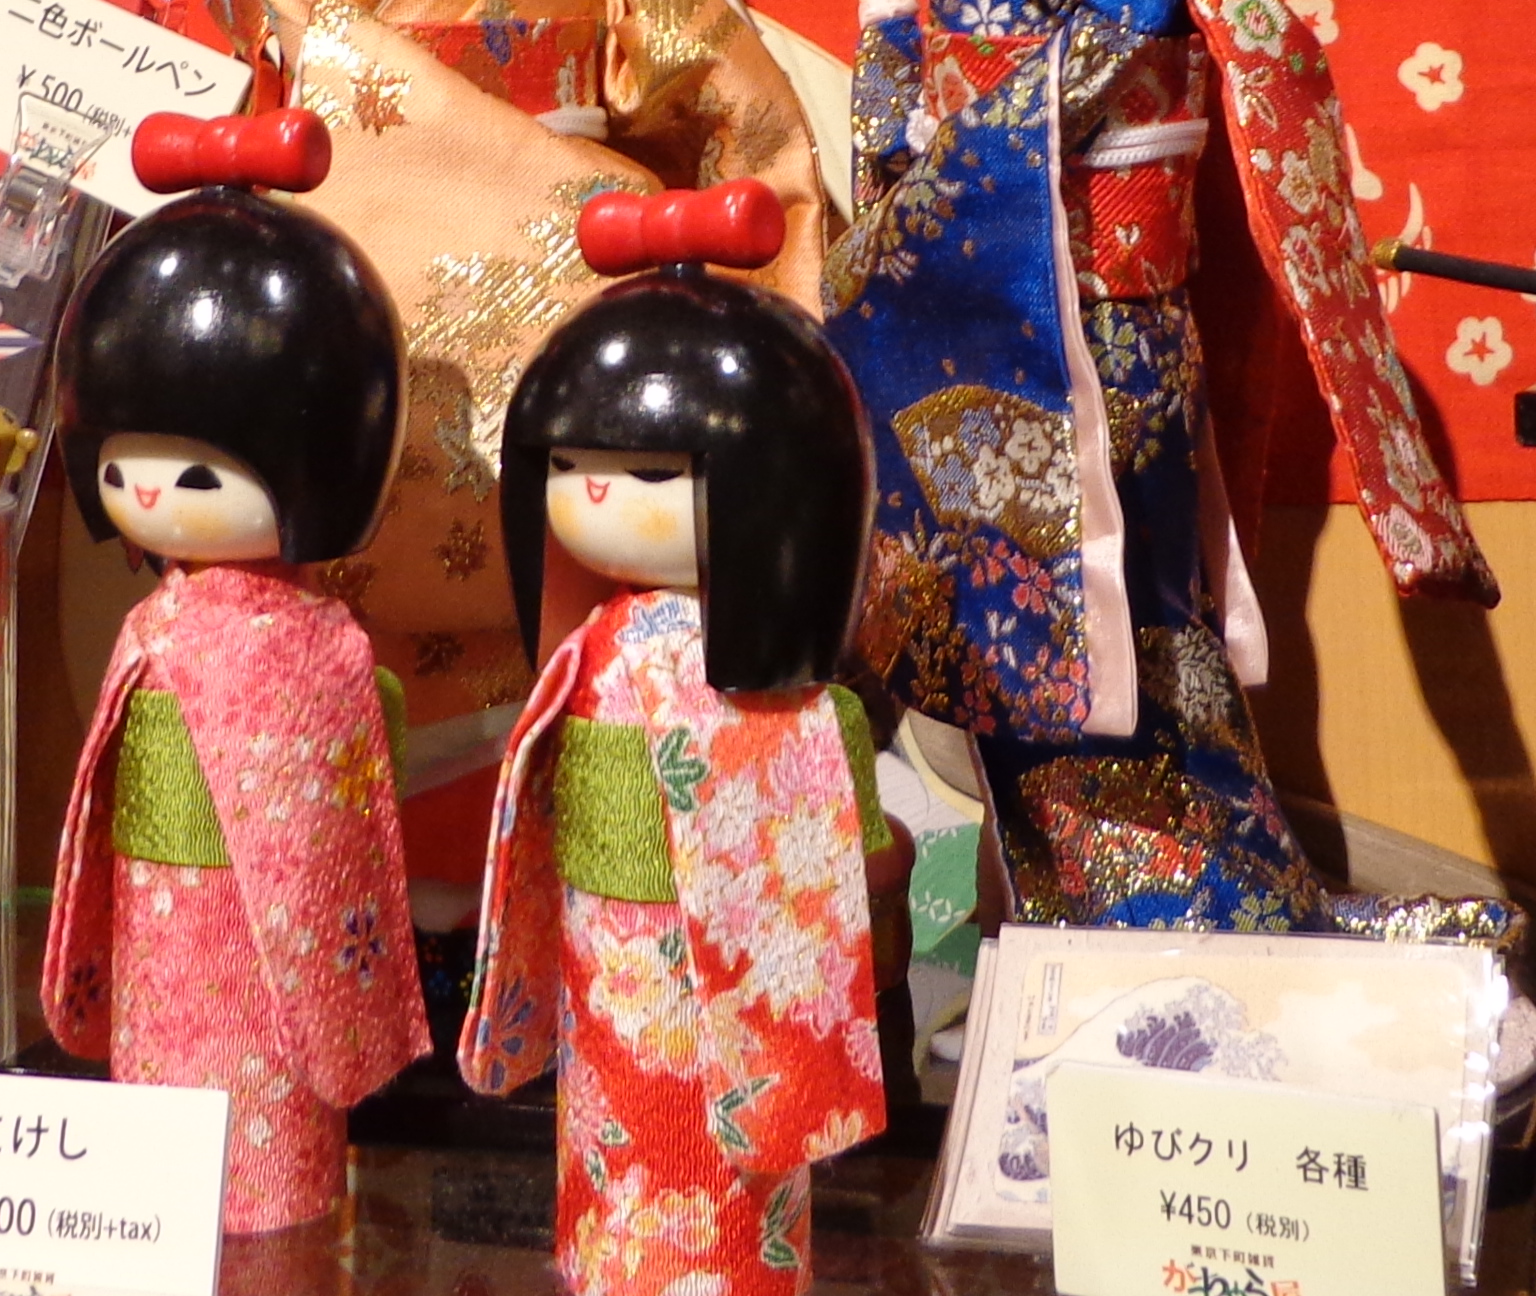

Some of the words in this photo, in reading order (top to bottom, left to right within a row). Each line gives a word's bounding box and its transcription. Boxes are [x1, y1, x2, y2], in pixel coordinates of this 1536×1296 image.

[1113, 1121, 1252, 1172] ゆびクリ
[1295, 1146, 1370, 1193] 各種
